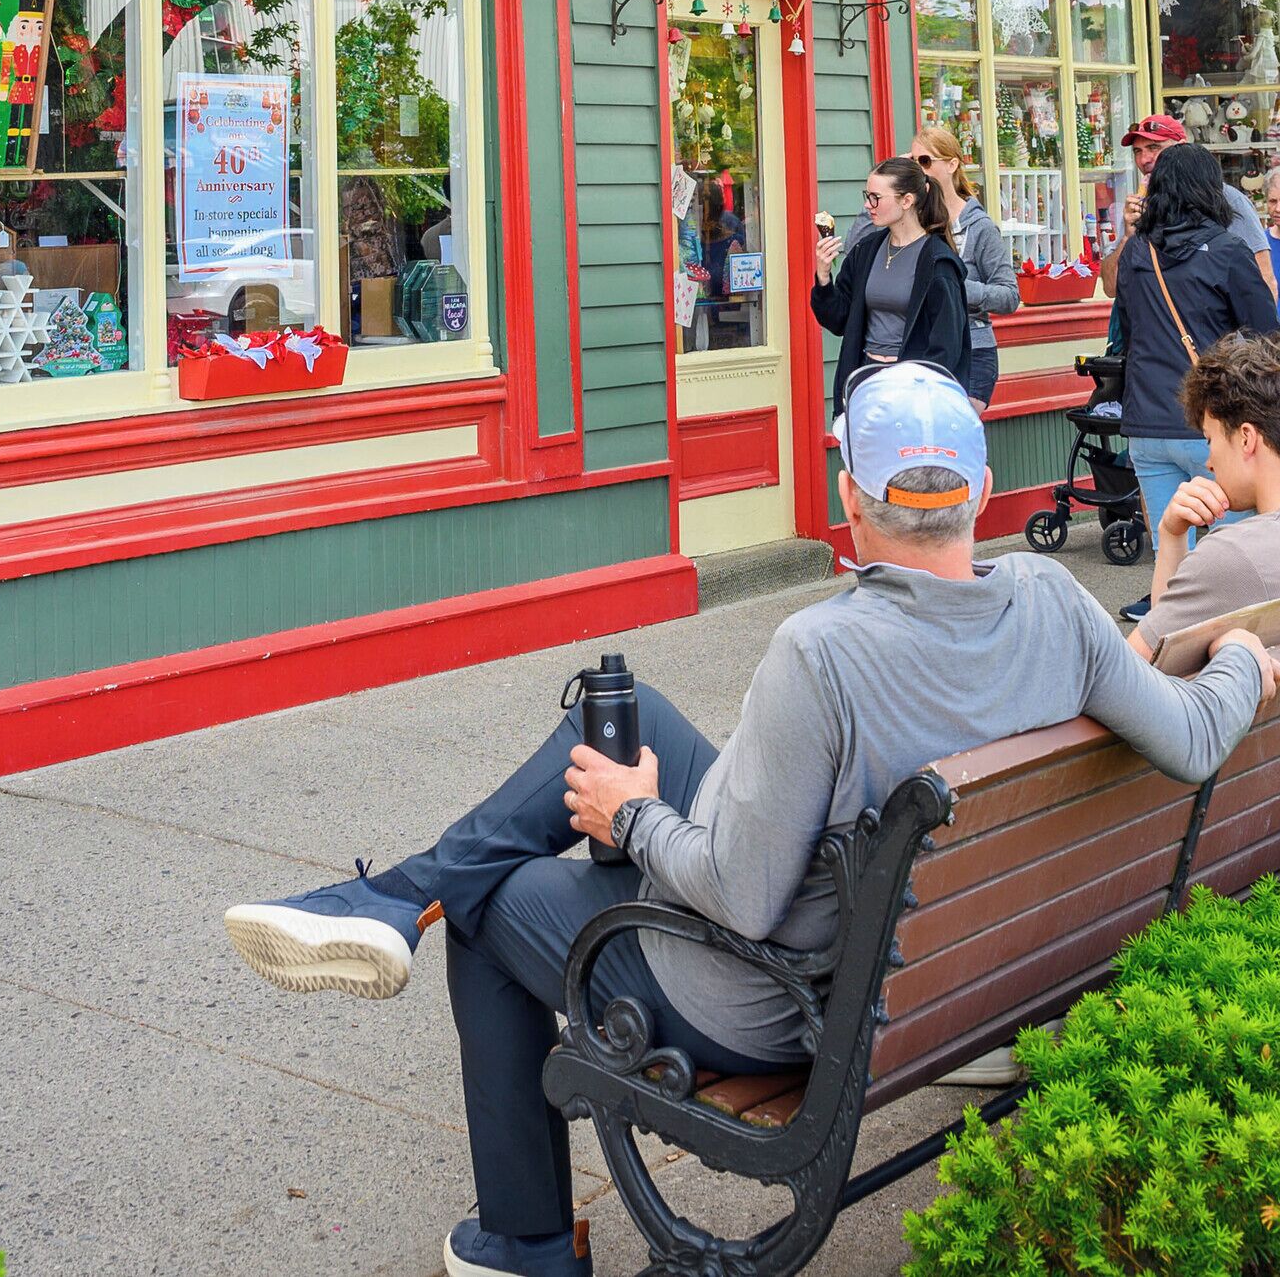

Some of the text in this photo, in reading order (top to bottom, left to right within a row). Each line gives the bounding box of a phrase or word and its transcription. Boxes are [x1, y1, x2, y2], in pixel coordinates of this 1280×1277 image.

[205, 115, 266, 130] Celebrating
[228, 132, 247, 140] our
[213, 145, 262, 175] 40th
[195, 179, 275, 195] Anniversary
[193, 207, 278, 222] In-store specials
[196, 245, 209, 257] all
[250, 243, 277, 257] long!
[447, 308, 464, 319] local
